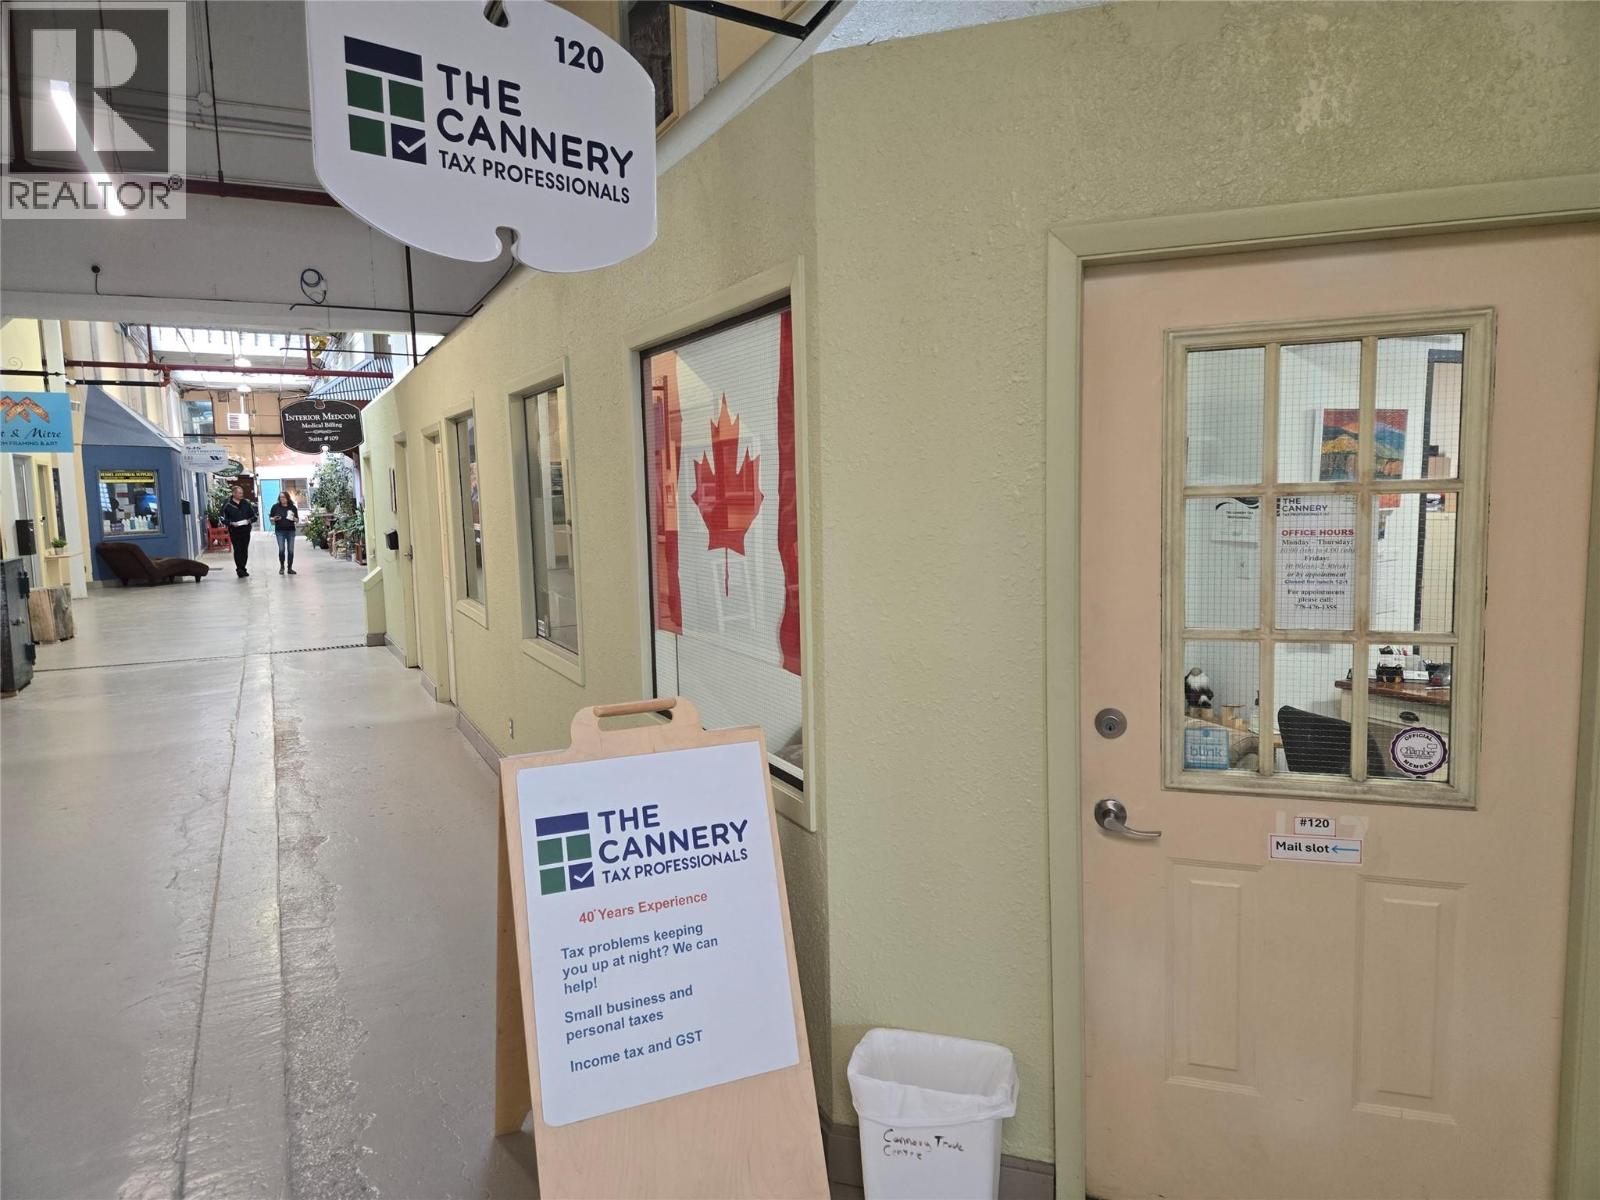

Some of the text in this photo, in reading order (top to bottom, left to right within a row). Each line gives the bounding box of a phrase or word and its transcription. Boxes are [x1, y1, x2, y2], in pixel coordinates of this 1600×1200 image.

[554, 35, 604, 74] 120
[436, 63, 522, 117] THE
[436, 107, 634, 178] CANNERY
[438, 149, 630, 204] TAX PROFESSIONALS
[284, 412, 357, 421] INTERIOR MEDCOM
[10, 429, 19, 438] &
[25, 427, 62, 439] Mitre
[1281, 504, 1328, 512] CANNERY
[1282, 497, 1302, 505] THE
[1281, 528, 1354, 537] OFFICE HOURS
[1404, 733, 1433, 742] OFFICIAL
[1403, 759, 1433, 769] MEMBER
[597, 804, 660, 834] THE
[1299, 817, 1330, 828] #120
[598, 819, 748, 864] CANNERY
[1275, 841, 1330, 853] Mail slot
[602, 848, 748, 884] TAX PROFESSIONALS
[598, 905, 634, 920] Years
[638, 892, 708, 914] Experience
[561, 924, 703, 960] Tax problems keeping
[562, 937, 718, 981] you up at night? We can
[564, 977, 598, 995] help!
[564, 984, 693, 1024] Small business and
[565, 1010, 664, 1045] personal taxes
[570, 1029, 703, 1073] Income tax and GST
[934, 1135, 964, 1152] Trade
